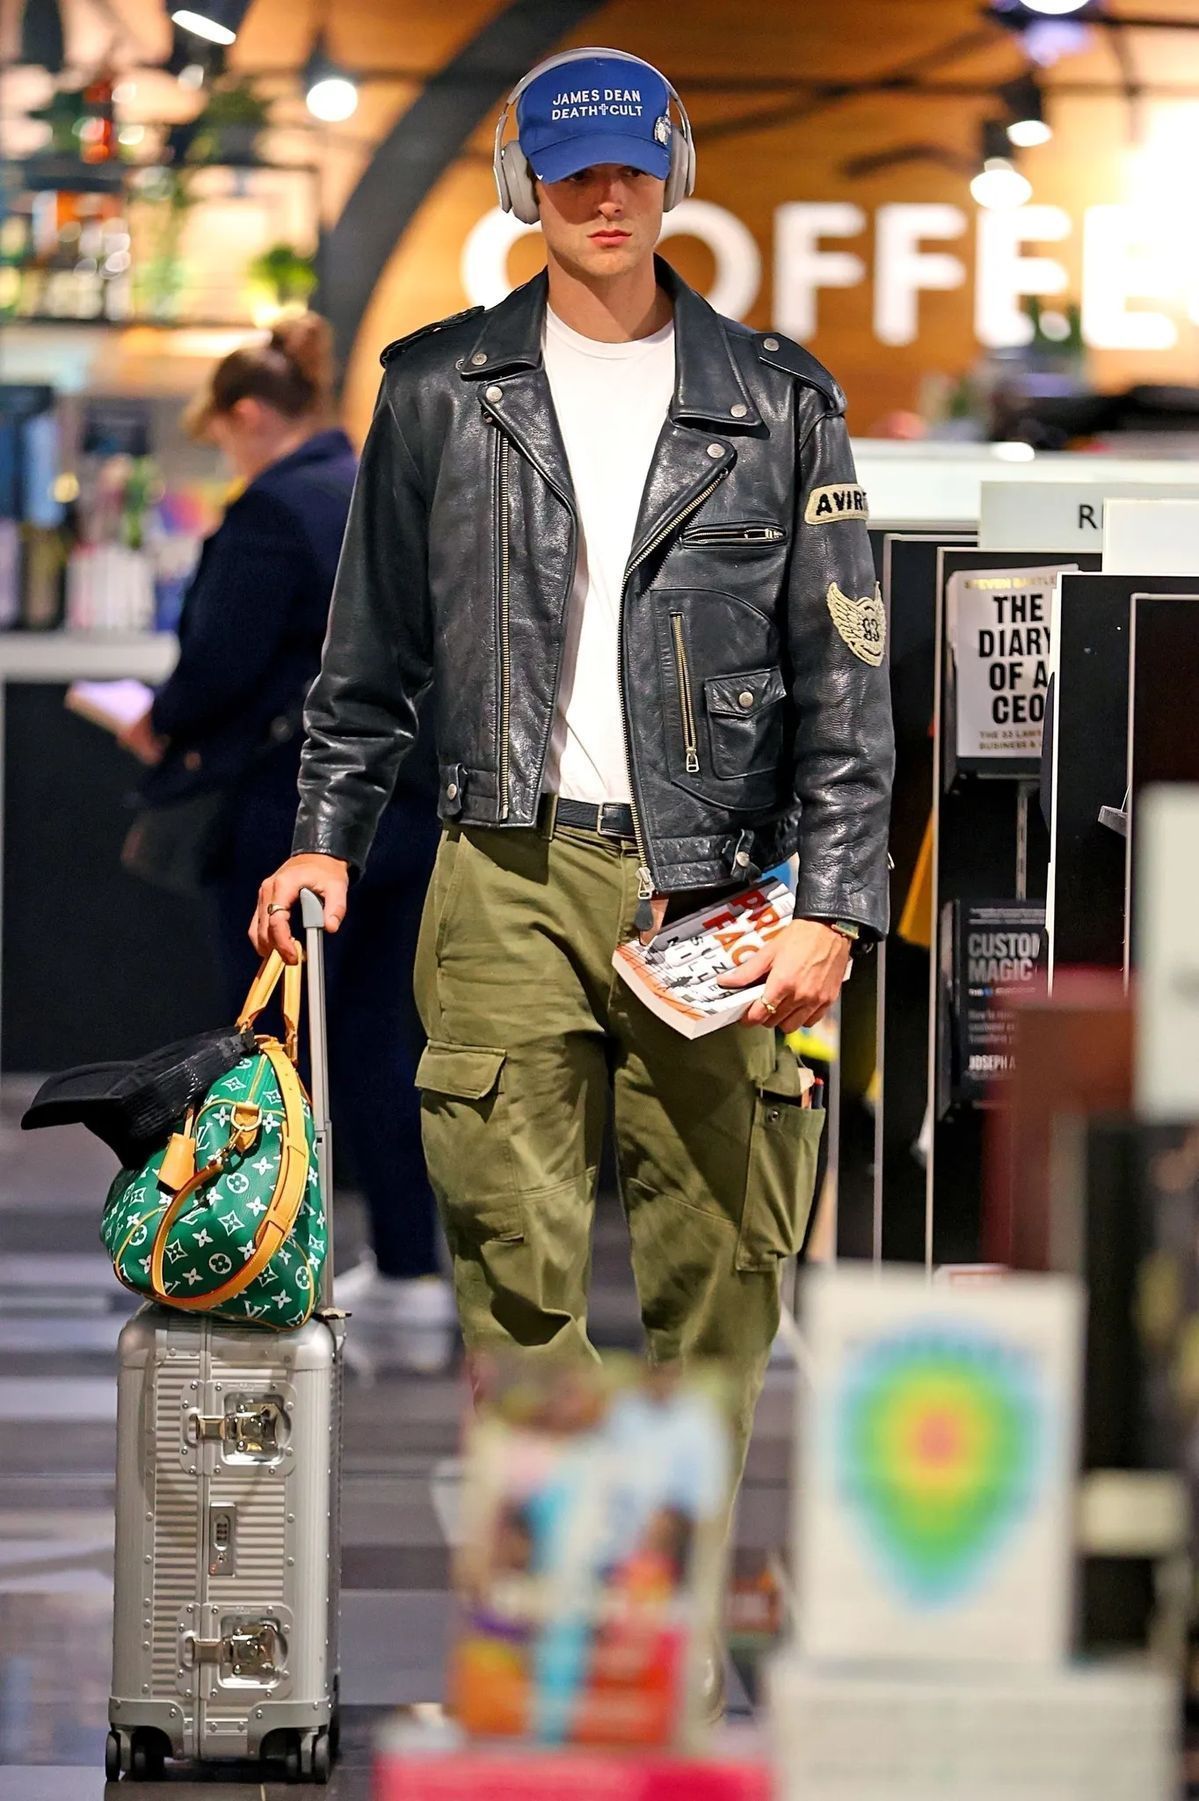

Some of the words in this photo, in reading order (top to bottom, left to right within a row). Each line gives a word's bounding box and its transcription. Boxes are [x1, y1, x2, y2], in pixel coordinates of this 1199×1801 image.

[552, 89, 600, 106] JAMES
[604, 89, 641, 102] DEAN
[552, 106, 598, 120] DEATH
[609, 105, 643, 117] CULT
[460, 198, 1178, 349] COFFEE
[816, 490, 867, 516] AVIR
[1078, 504, 1103, 529] R
[992, 594, 1043, 623] THE
[989, 662, 1024, 691] OF
[1033, 661, 1048, 689] A
[992, 694, 1045, 724] CEO
[730, 889, 789, 942] PRI
[702, 911, 762, 967] FAC
[968, 958, 1034, 983] MAGIC
[968, 1054, 1008, 1070] JOSEPH
